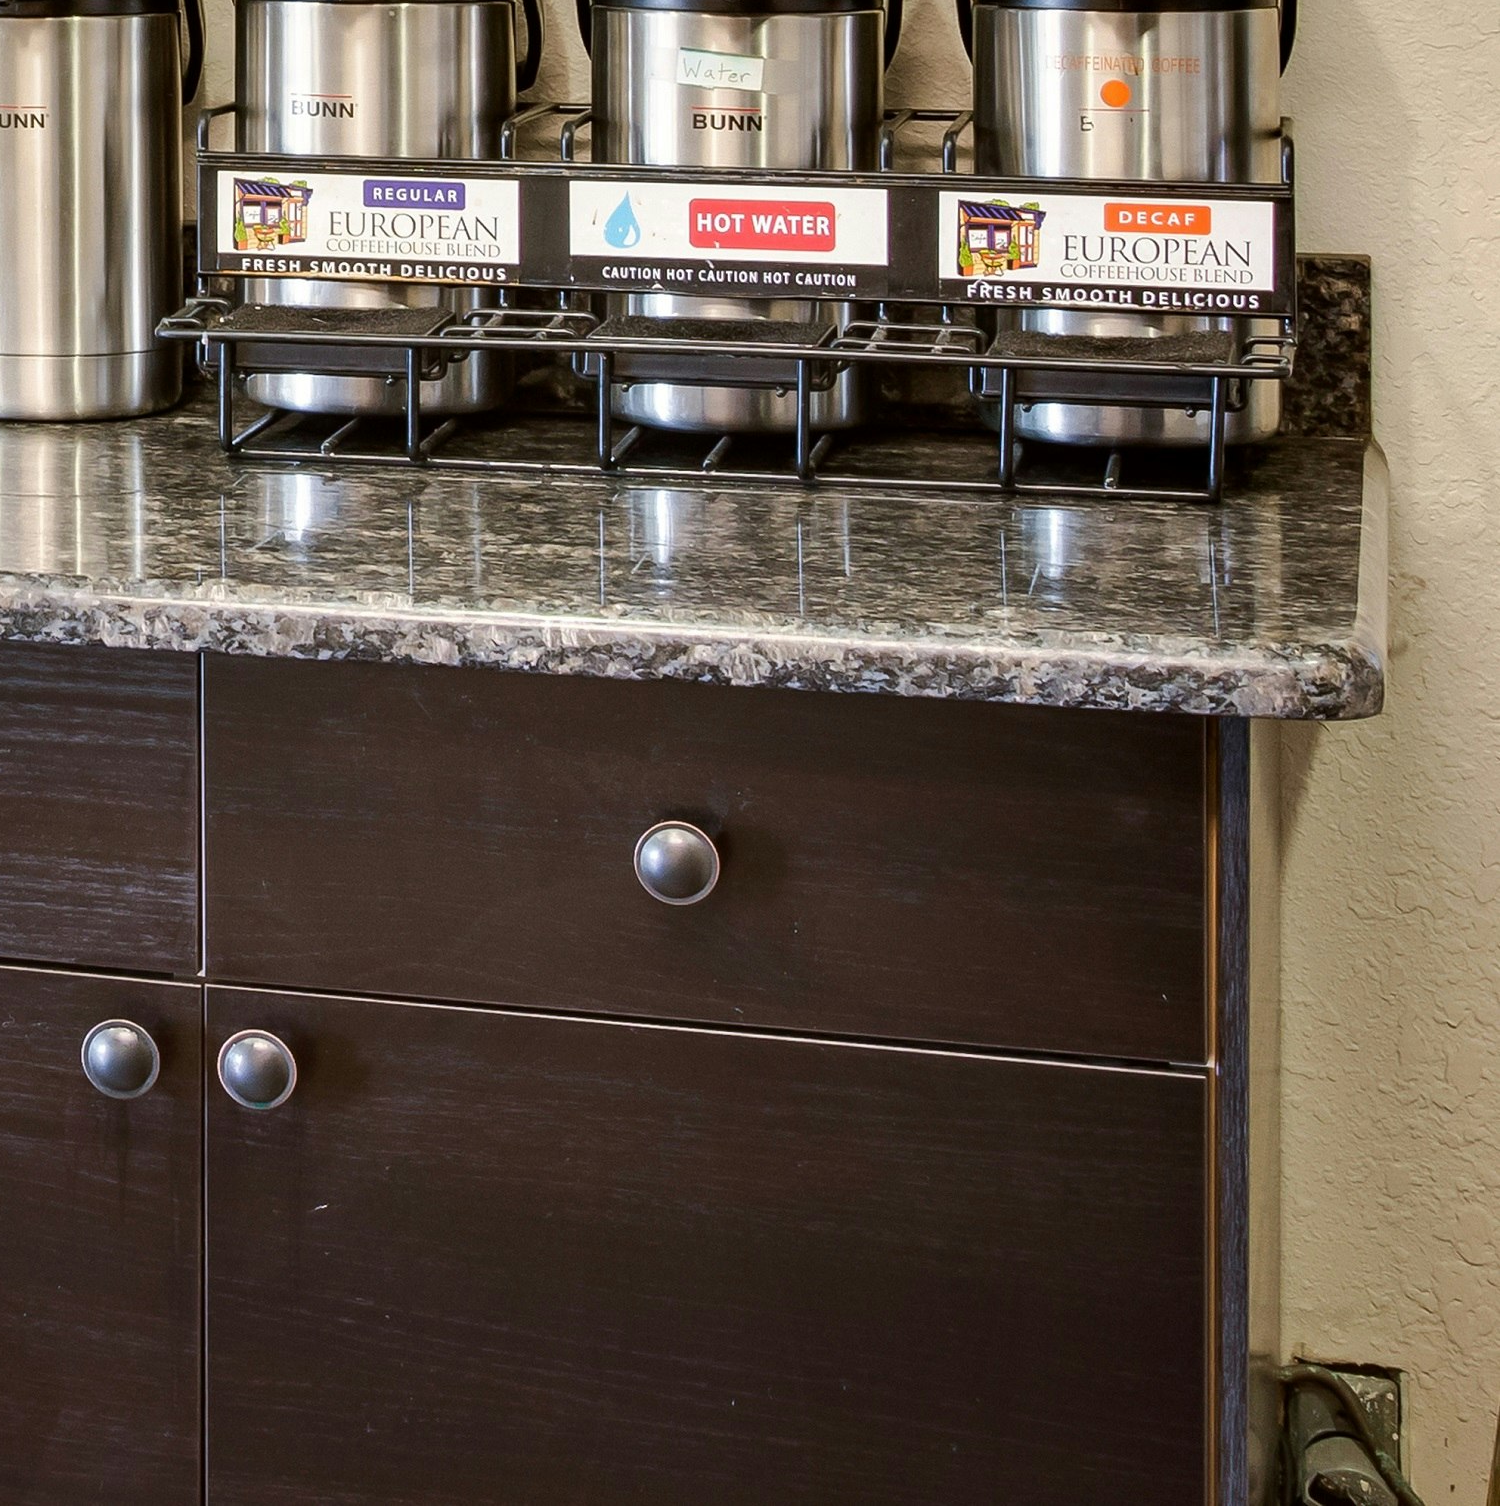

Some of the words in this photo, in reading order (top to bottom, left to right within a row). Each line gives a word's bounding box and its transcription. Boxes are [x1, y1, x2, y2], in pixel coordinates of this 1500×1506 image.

[683, 58, 751, 83] Water
[1152, 57, 1201, 74] COFFEE
[291, 100, 354, 118] BUNN
[693, 113, 762, 131] BUNN
[372, 187, 459, 203] REGULAR
[329, 211, 500, 241] EUROPEAN
[696, 213, 745, 233] HOT
[751, 214, 830, 236] WATER
[1118, 210, 1195, 226] DECAF
[326, 238, 442, 256] COFFEEHOUSE
[447, 243, 501, 258] BLEND
[1063, 234, 1251, 268] EUROPEAN
[242, 257, 301, 273] FRESH
[309, 260, 392, 276] SMOOTH
[400, 264, 507, 281] DELICIOUS
[602, 266, 661, 280] CAUTION
[666, 268, 694, 281] HOT
[698, 269, 759, 283] CAUTION
[763, 271, 791, 285] HOT
[795, 273, 857, 287] CAUTION
[1060, 264, 1187, 283] COFFEEHOUSE
[1193, 268, 1254, 284] BLEND
[966, 283, 1034, 300] FRESH
[1042, 287, 1133, 303] SMOOTH
[1142, 290, 1260, 309] DELICIOUS
